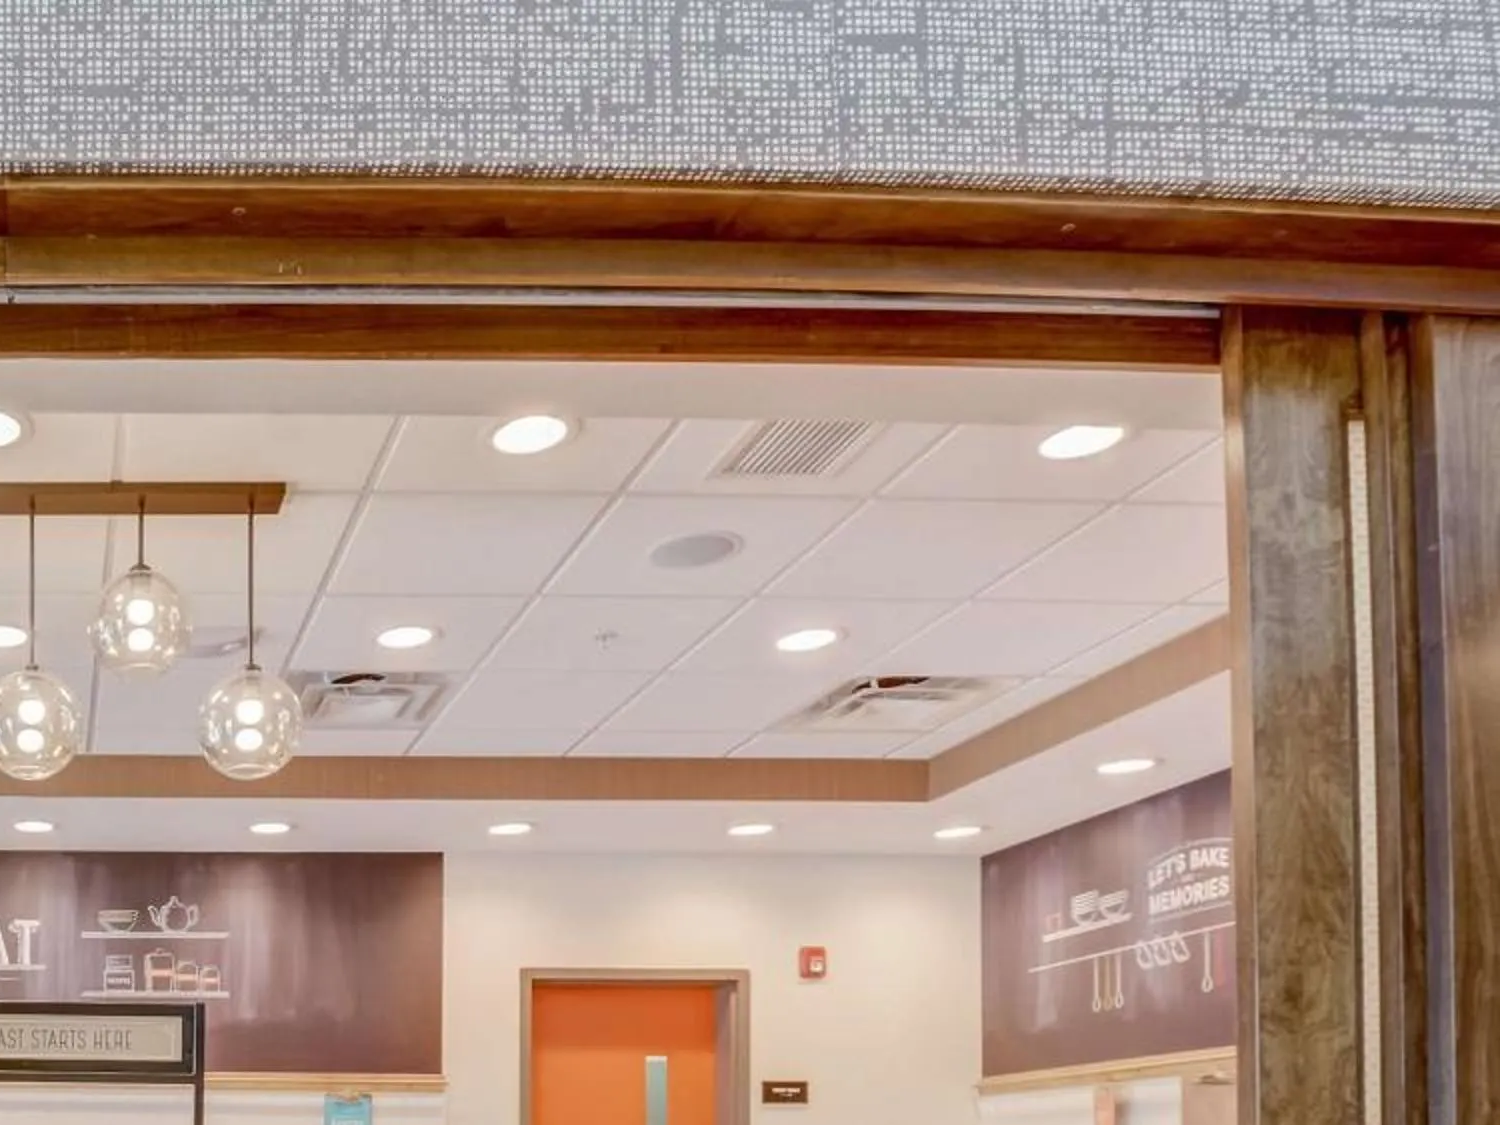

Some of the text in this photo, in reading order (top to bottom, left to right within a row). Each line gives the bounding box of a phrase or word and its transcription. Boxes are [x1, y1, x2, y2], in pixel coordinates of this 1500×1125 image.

[1147, 847, 1230, 890] LET'S BAKE
[1147, 875, 1230, 915] MEMORIES
[30, 1028, 88, 1050] STARTS
[93, 1029, 133, 1050] HERE
